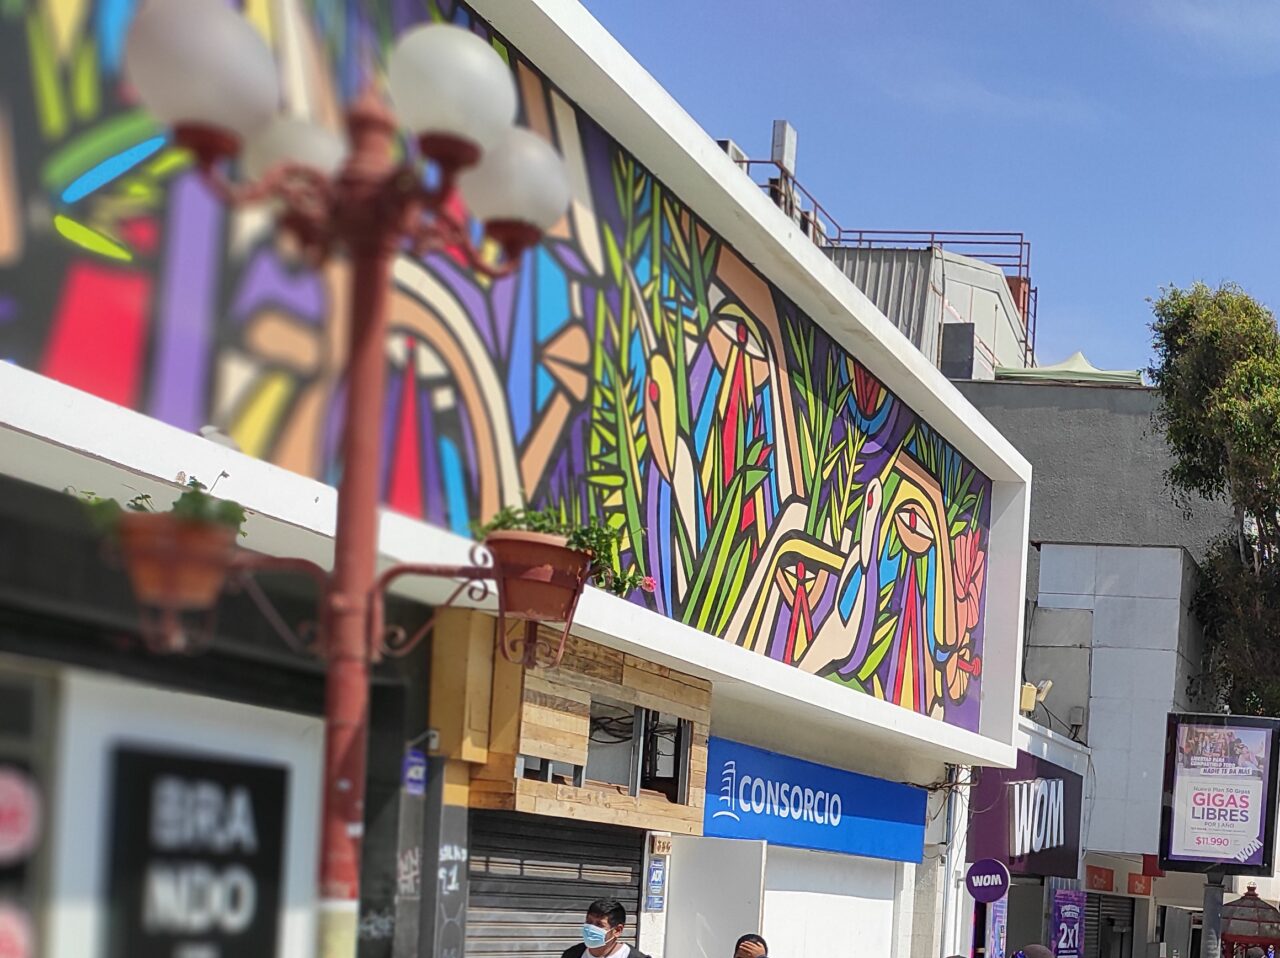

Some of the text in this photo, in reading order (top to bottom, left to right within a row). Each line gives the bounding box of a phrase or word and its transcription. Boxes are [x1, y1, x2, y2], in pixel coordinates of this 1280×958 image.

[739, 775, 841, 826] CONSORCIO
[1192, 792, 1249, 808] GIGAS
[152, 775, 258, 853] BRA
[1012, 778, 1064, 857] WOM
[1192, 806, 1249, 822] LIBRES
[1195, 836, 1229, 846] $11.990
[1236, 839, 1263, 863] WOM
[971, 873, 1002, 887] WOM
[143, 863, 258, 934] NDO
[1058, 922, 1079, 948] 2x1
